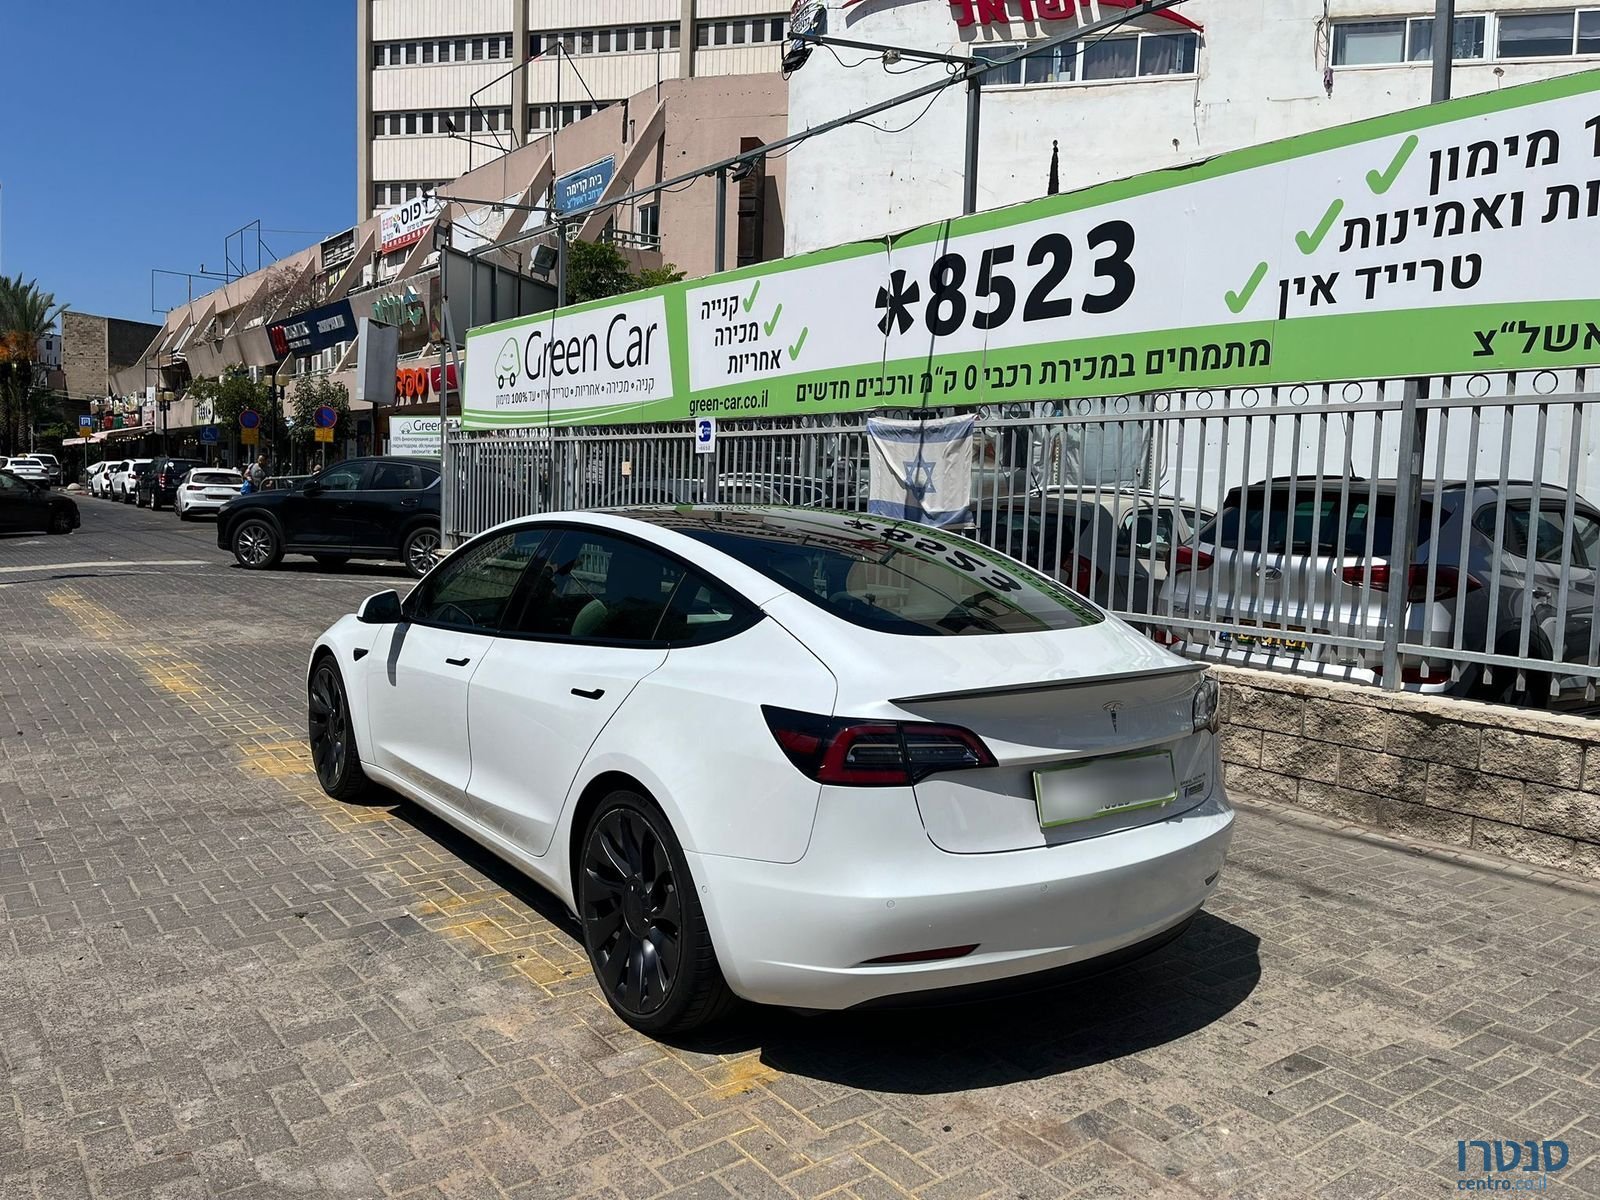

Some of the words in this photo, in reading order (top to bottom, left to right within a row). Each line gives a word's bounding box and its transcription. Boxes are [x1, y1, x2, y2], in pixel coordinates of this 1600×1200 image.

[1429, 128, 1560, 196] מימון
[589, 174, 603, 188] בית
[401, 200, 429, 225] דפוס
[1339, 191, 1524, 252] ואמינות
[1355, 252, 1482, 300] טרייד
[701, 295, 739, 321] קנייה
[1278, 272, 1340, 320] אין
[714, 321, 759, 346] מכירה
[525, 331, 598, 380] Green
[606, 313, 658, 369] Car
[1146, 338, 1271, 375] מתמחים
[727, 349, 782, 374] אחריות
[1039, 353, 1135, 384] במכירת
[606, 380, 629, 394] מכירה
[636, 377, 655, 394] קניה
[856, 374, 913, 397] ורכבים
[920, 366, 957, 394] ק"מ
[964, 364, 977, 390] 0
[984, 363, 1032, 389] רכבי
[512, 392, 527, 404] 100%
[528, 391, 536, 401] עד
[552, 386, 570, 399] טרייד
[575, 383, 600, 398] אחריות
[689, 389, 768, 416] green-car.co.il
[796, 380, 850, 402] חדשים
